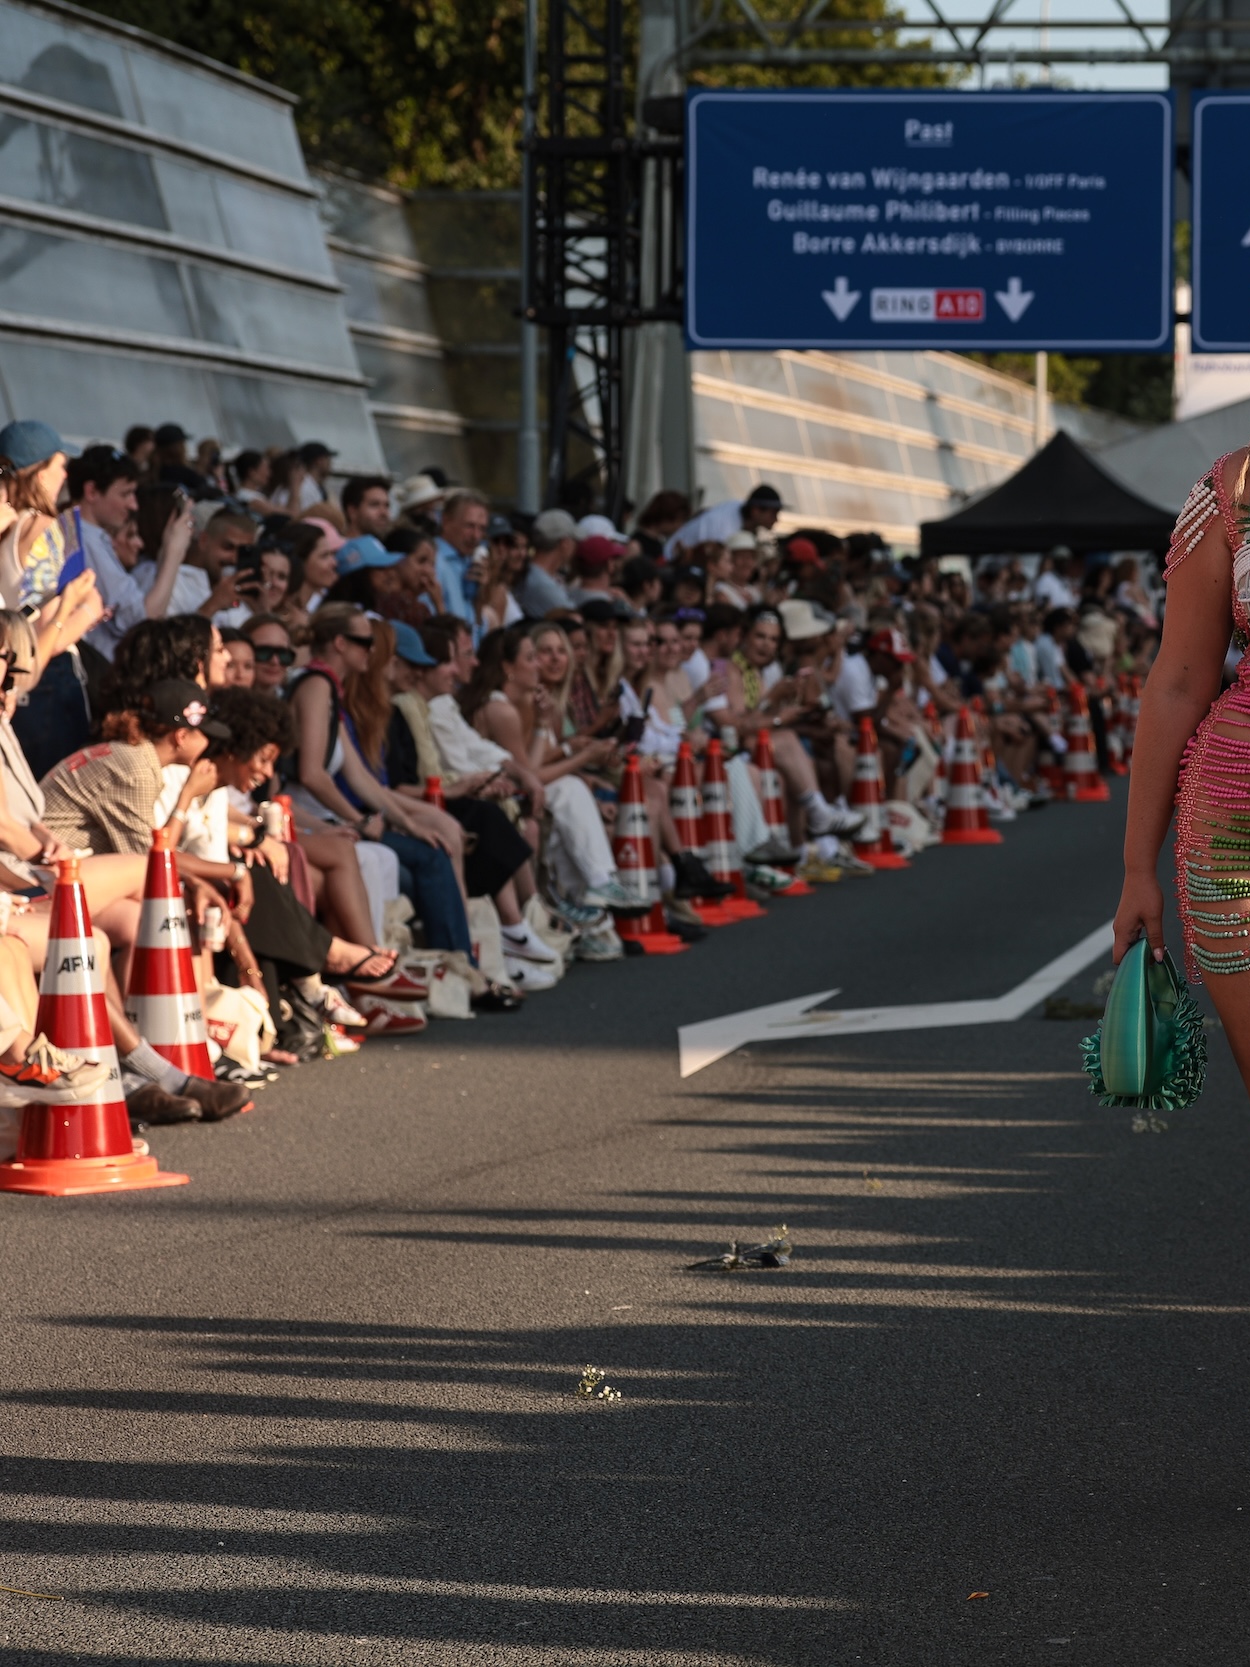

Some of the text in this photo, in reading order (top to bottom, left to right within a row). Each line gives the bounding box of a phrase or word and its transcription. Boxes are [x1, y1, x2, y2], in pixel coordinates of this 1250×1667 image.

[904, 119, 954, 140] Past
[752, 166, 822, 189] Renée
[827, 171, 866, 189] van
[871, 168, 1010, 194] Wijngaarden
[767, 199, 880, 222] Guillaume
[885, 199, 980, 222] Philibert
[792, 231, 856, 254] Borre
[860, 232, 981, 258] Akkersdijk
[875, 294, 979, 315] RING A10
